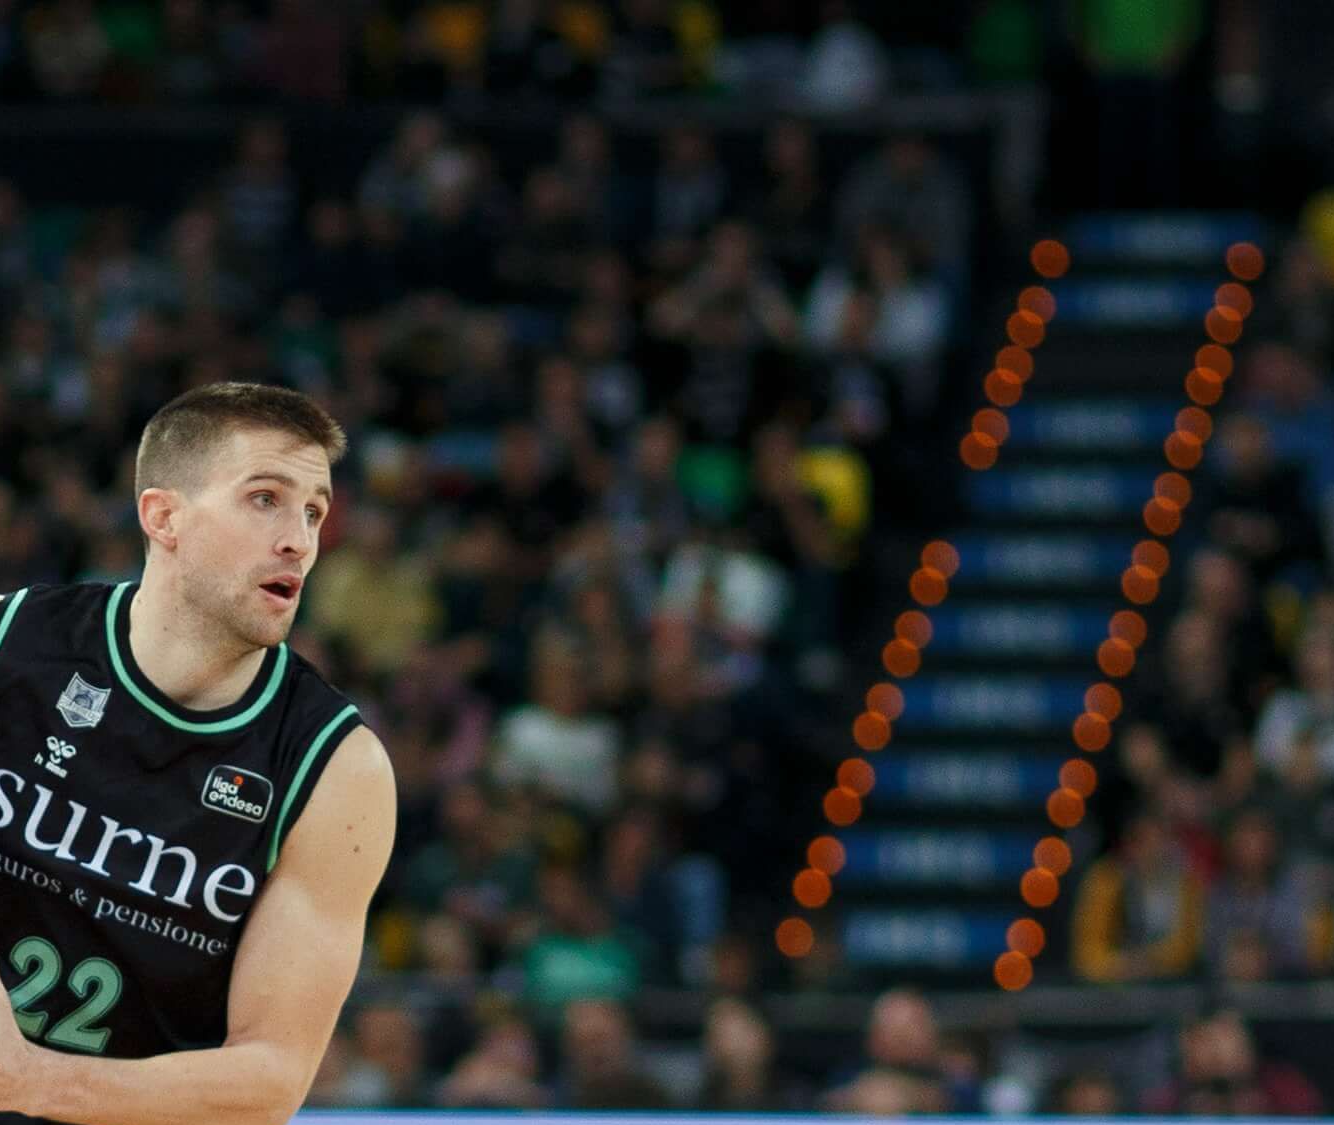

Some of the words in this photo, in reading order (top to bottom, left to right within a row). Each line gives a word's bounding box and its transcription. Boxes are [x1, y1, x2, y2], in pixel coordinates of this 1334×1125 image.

[208, 790, 264, 816] endesa
[212, 775, 239, 795] liga
[69, 886, 88, 907] &
[94, 896, 229, 956] pensione
[9, 935, 123, 1051] 22
